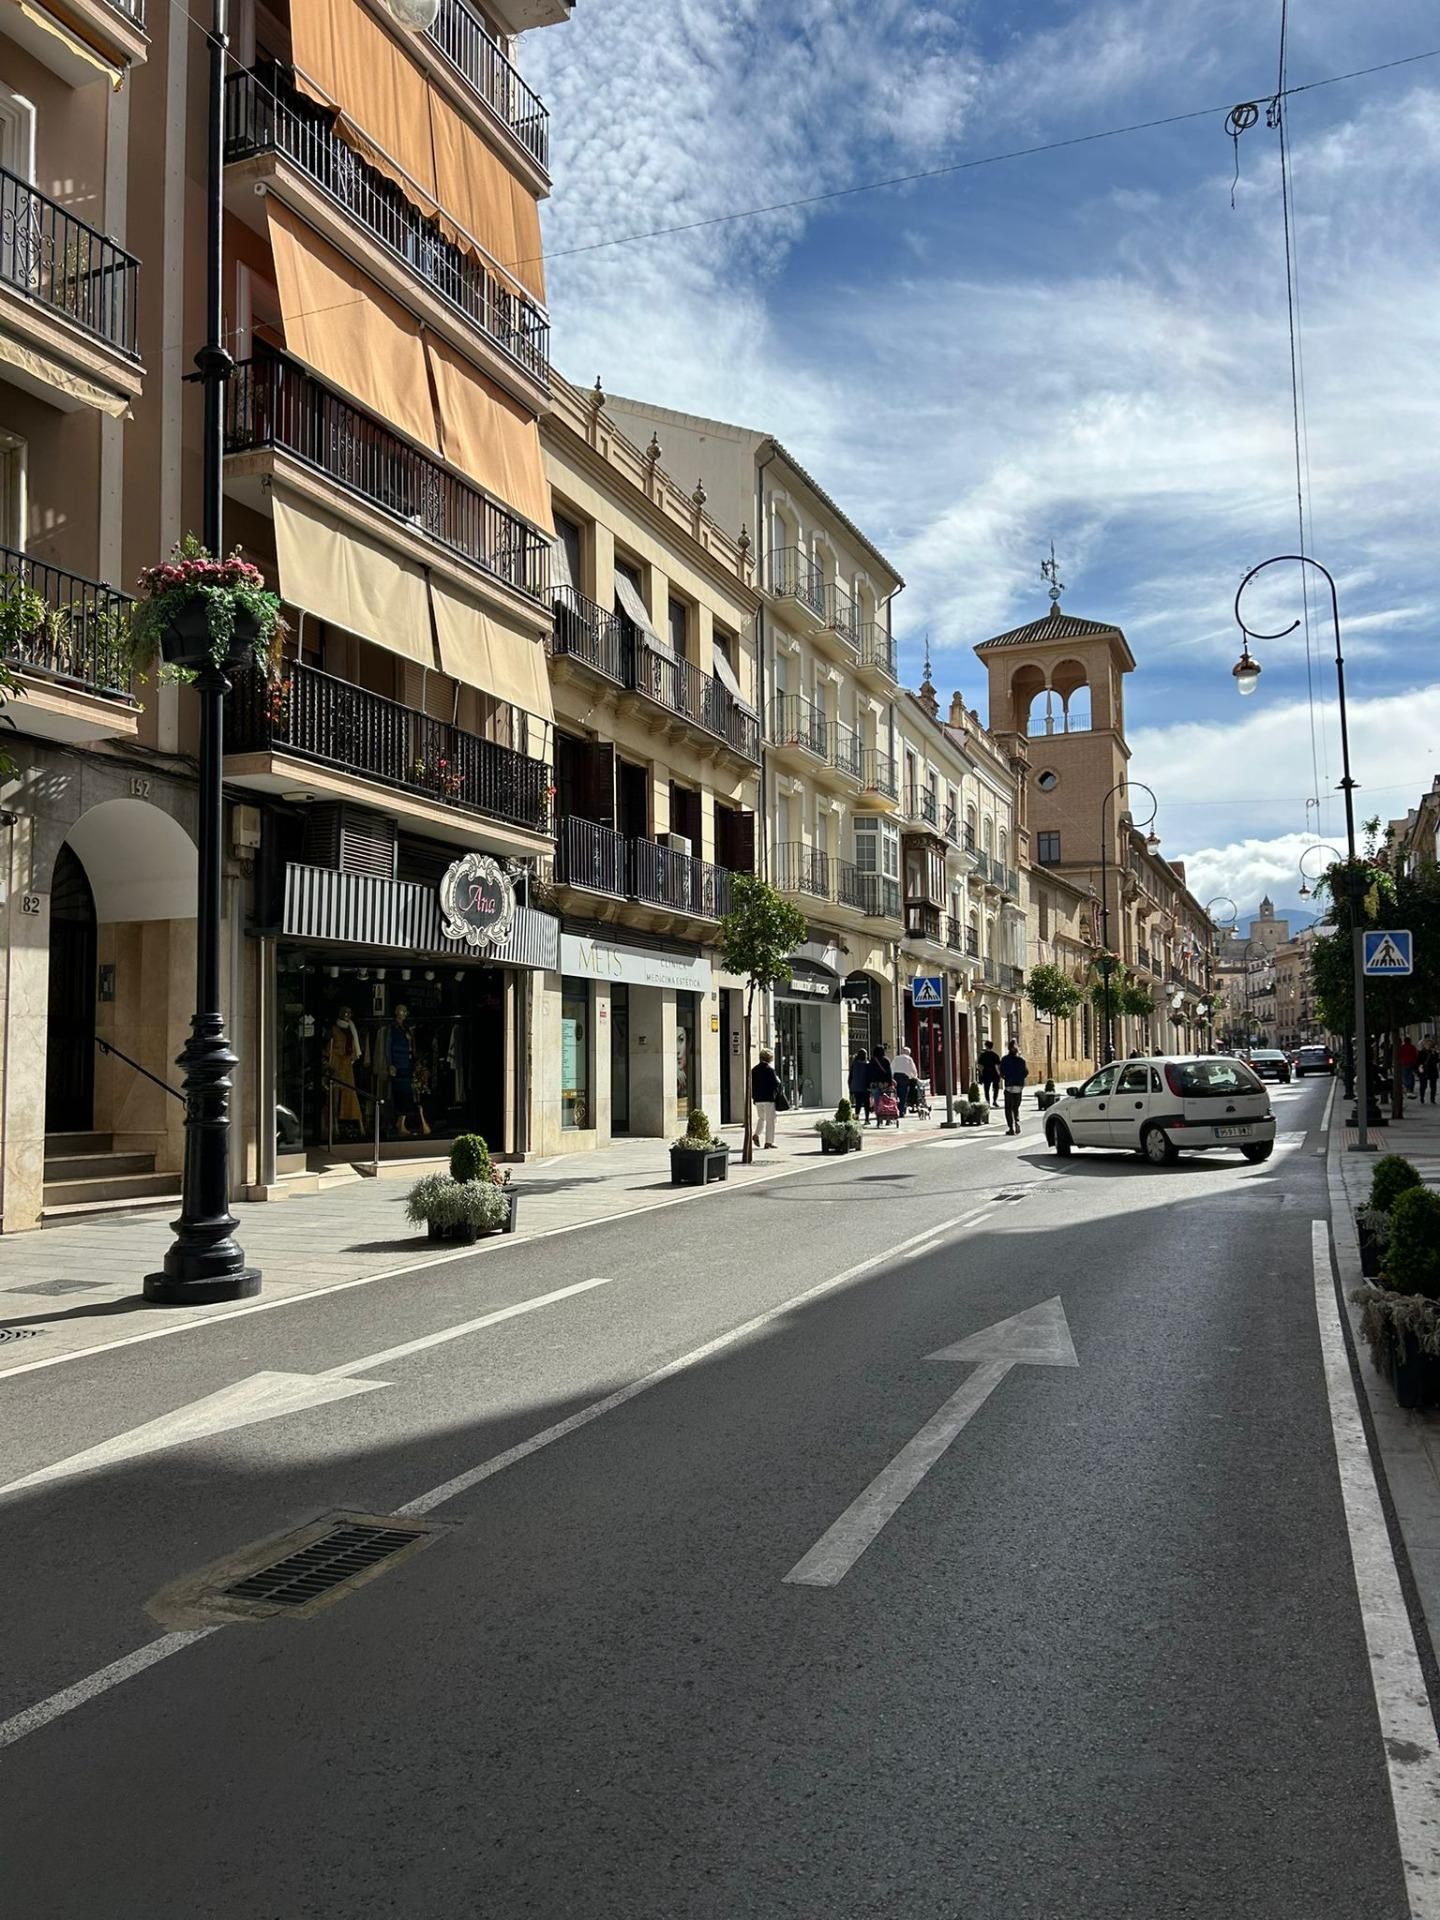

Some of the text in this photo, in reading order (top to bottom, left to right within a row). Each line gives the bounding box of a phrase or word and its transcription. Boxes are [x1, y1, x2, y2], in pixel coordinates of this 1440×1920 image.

[22, 895, 40, 914] 82
[458, 884, 497, 914] Ana
[577, 940, 623, 977] METS
